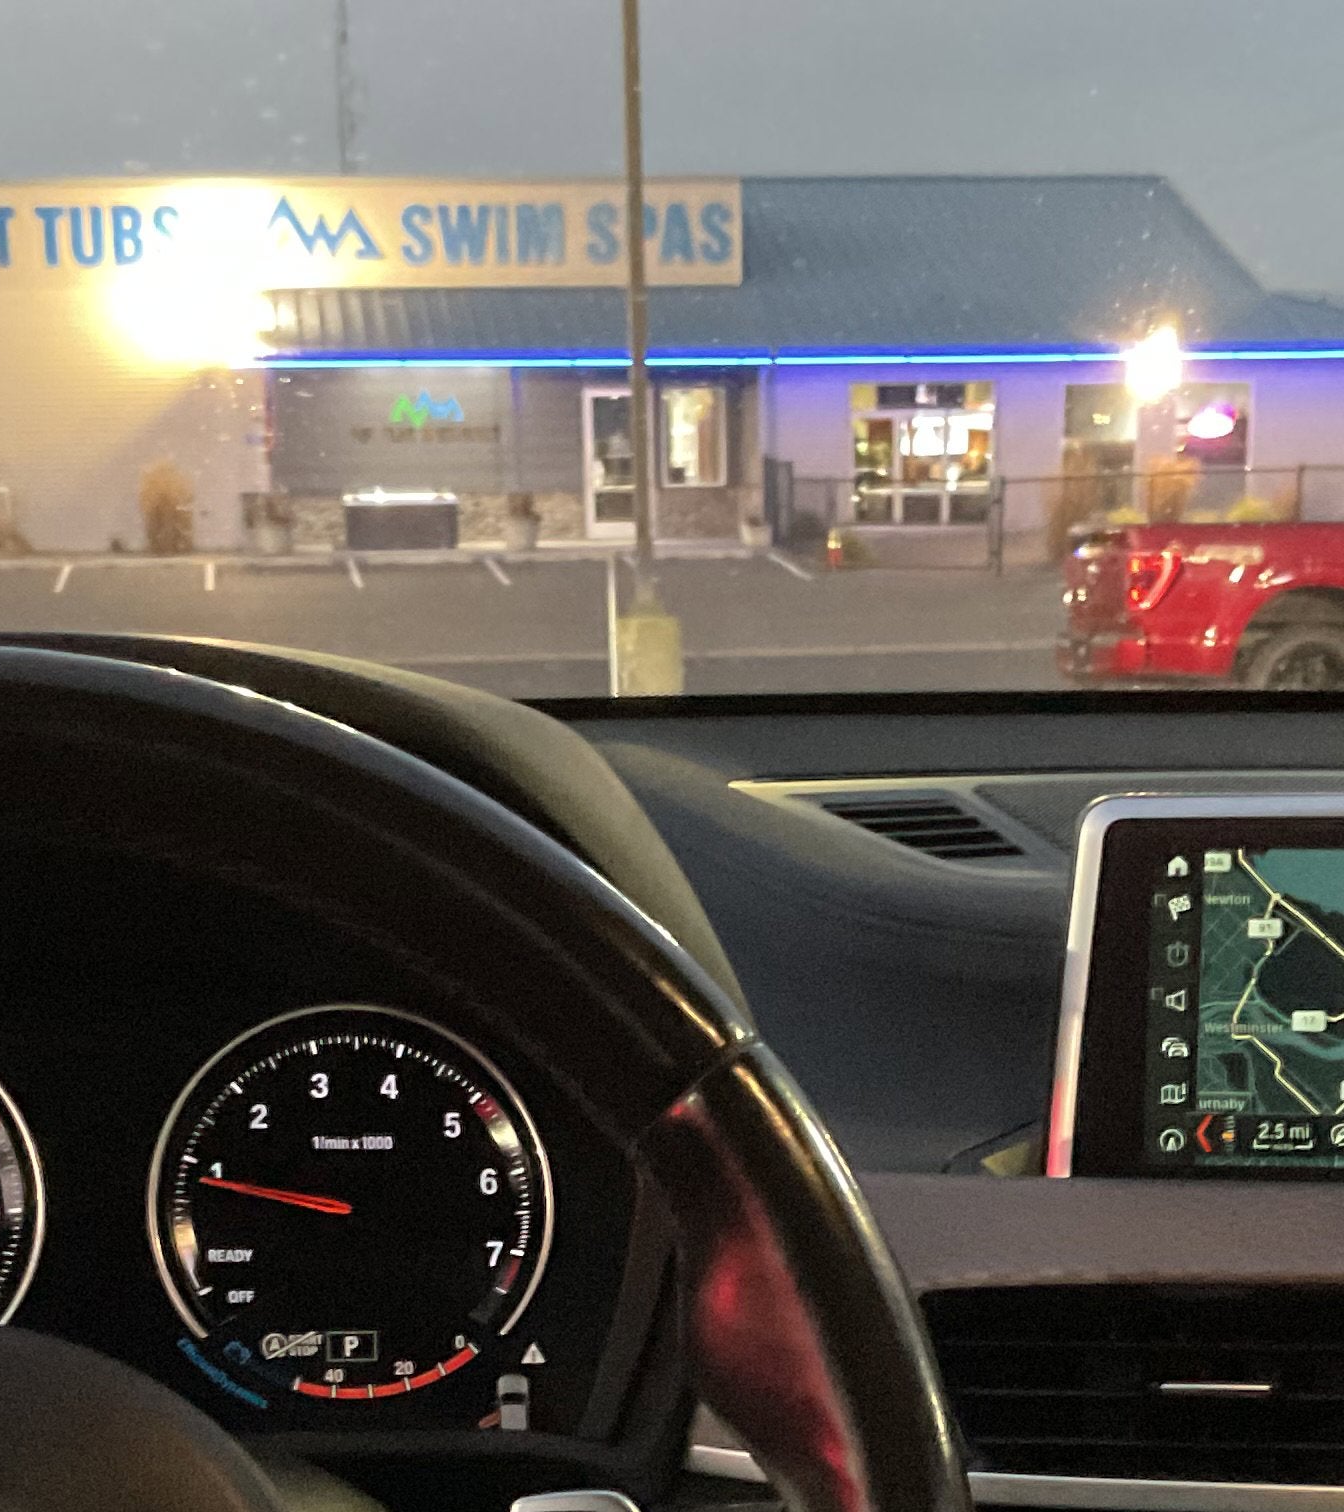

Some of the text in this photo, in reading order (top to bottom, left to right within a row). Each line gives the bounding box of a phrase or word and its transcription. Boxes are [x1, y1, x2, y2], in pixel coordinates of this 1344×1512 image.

[400, 203, 566, 267] SWIM
[309, 1073, 330, 1099] 3
[379, 1074, 399, 1099] 4
[249, 1104, 269, 1129] 2
[443, 1112, 462, 1138] 5
[1257, 1123, 1310, 1140] 2.5 mi
[312, 1135, 350, 1150] 1/min
[362, 1135, 394, 1150] 1000
[209, 1162, 223, 1179] 1
[479, 1168, 499, 1195] 6
[207, 1248, 254, 1264] READY
[485, 1241, 504, 1267] 7
[227, 1289, 255, 1304] OFF
[343, 1335, 360, 1358] P
[454, 1334, 466, 1351] 0
[323, 1368, 345, 1384] 40
[393, 1360, 416, 1376] 20
